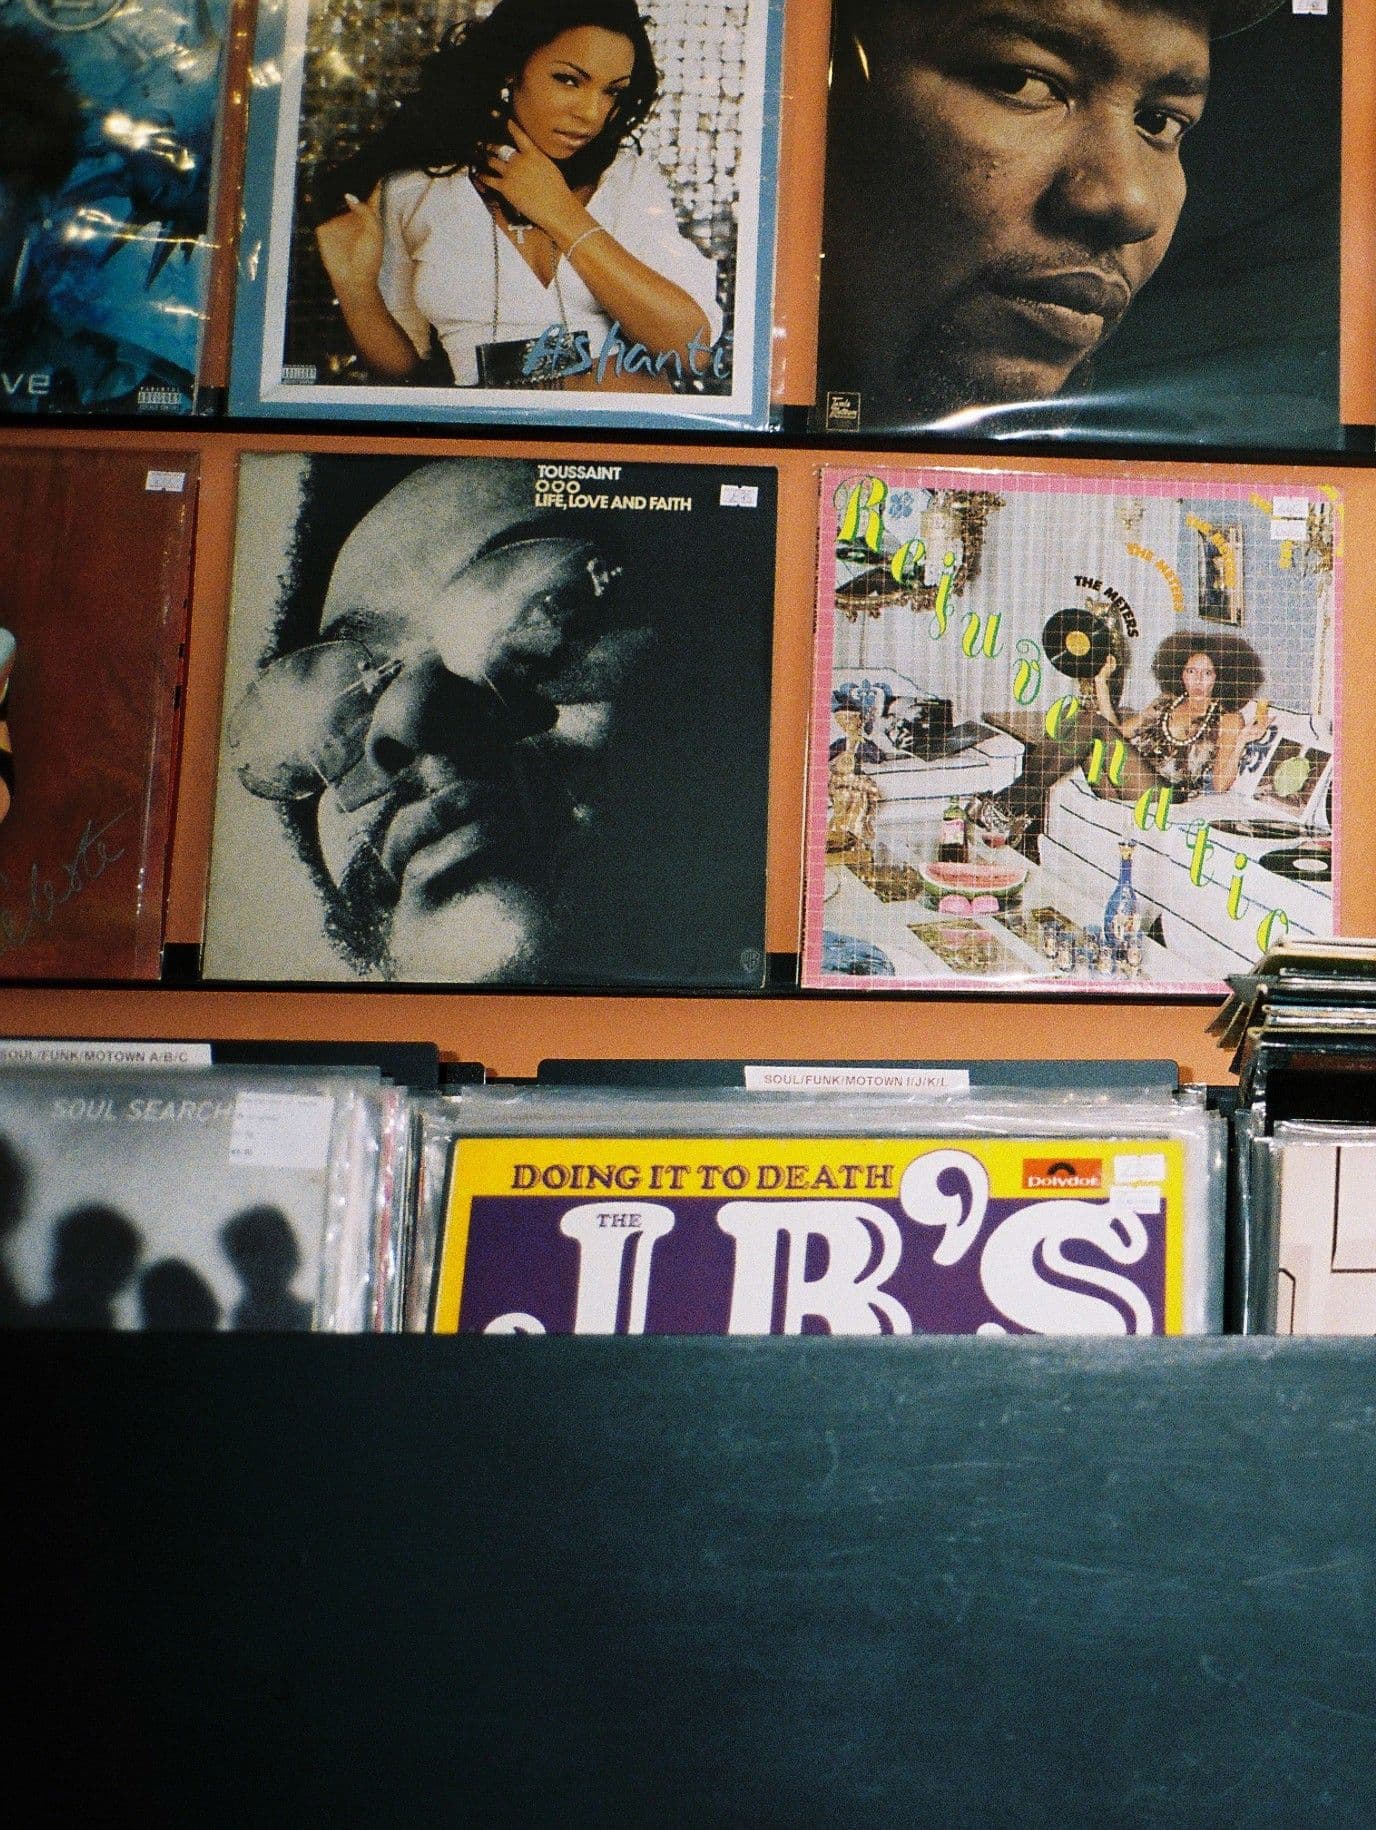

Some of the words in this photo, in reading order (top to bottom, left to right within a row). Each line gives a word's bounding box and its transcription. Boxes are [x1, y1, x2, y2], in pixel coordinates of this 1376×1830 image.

[537, 464, 622, 481] TOUSSAINT
[568, 494, 609, 510] LOVE
[610, 496, 647, 511] AND
[649, 497, 693, 512] FAITH
[1074, 574, 1103, 592] THE
[1103, 586, 1140, 639] METERS
[53, 1098, 117, 1122] SOUL
[511, 1164, 641, 1190] DOING
[648, 1164, 691, 1190] IT
[699, 1164, 750, 1190] TO
[757, 1164, 894, 1190] DEATH
[596, 1212, 643, 1228] THE
